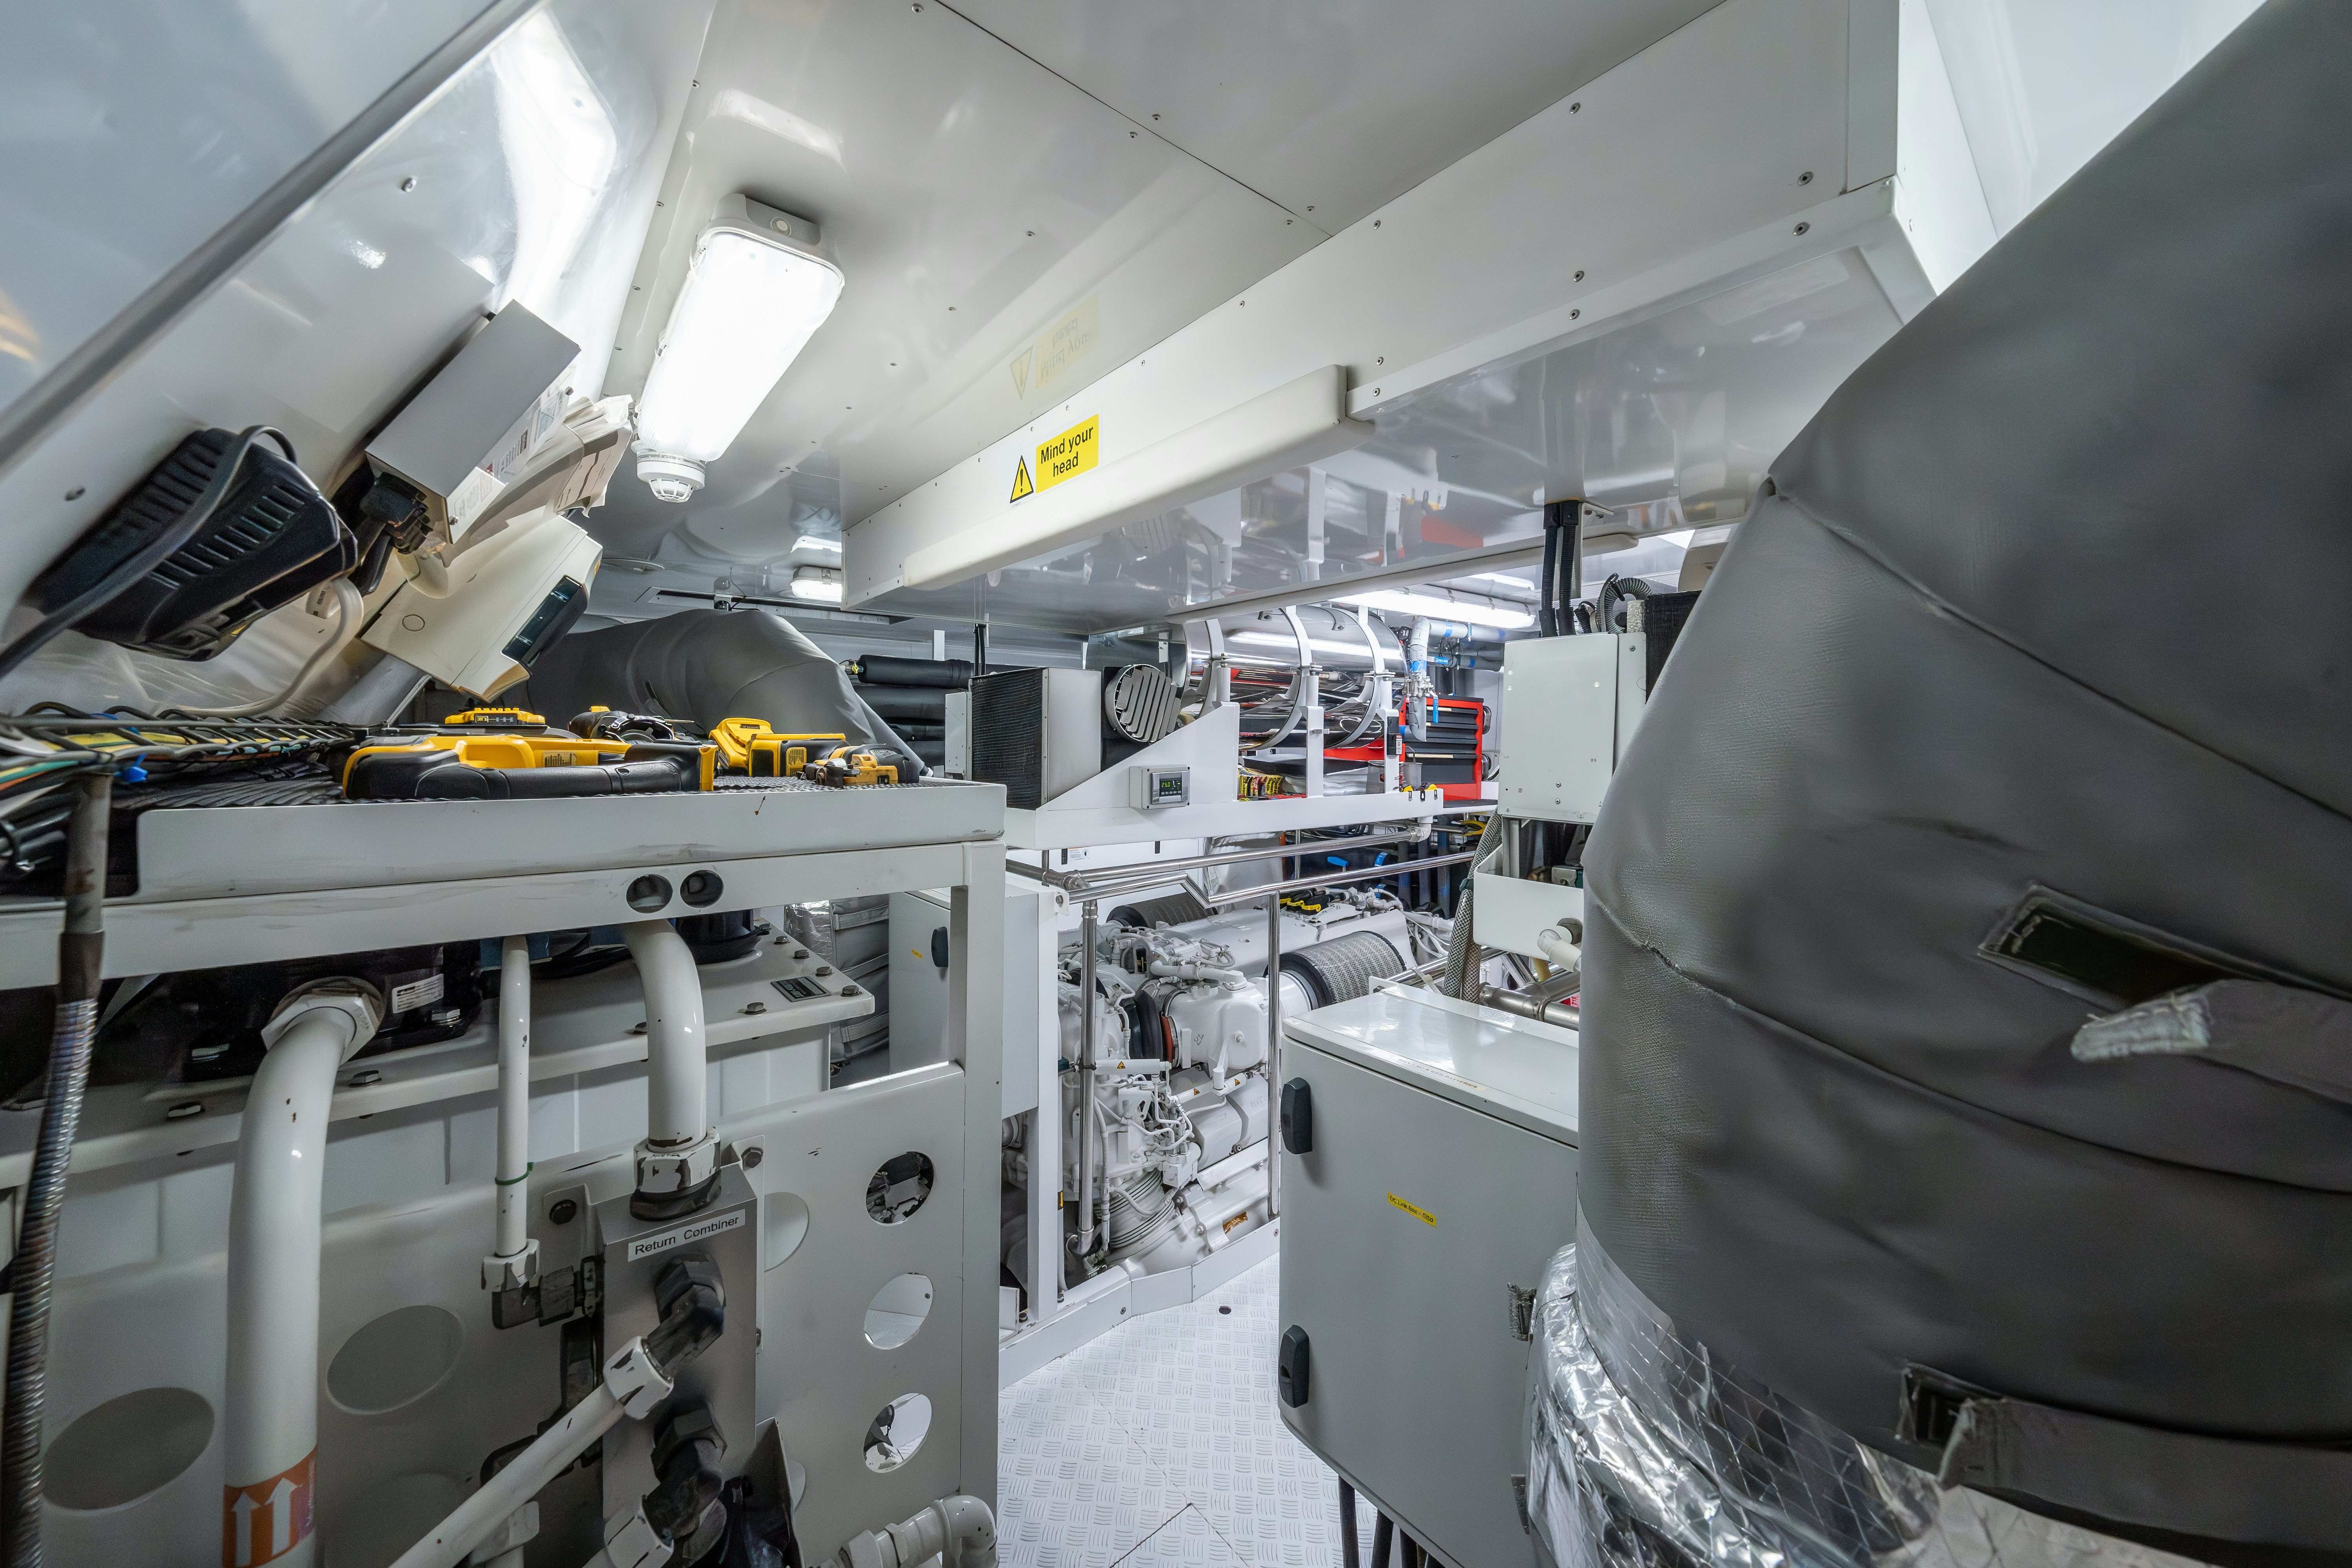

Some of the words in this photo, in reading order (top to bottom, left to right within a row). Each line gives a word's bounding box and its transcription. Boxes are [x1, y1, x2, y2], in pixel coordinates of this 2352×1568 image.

[1041, 438, 1065, 464] Mind
[1069, 426, 1093, 453] your
[1053, 451, 1078, 477] head
[1445, 1075, 1477, 1088] BATTERIES
[1397, 1200, 1408, 1209] Link
[635, 1236, 676, 1255] Return
[683, 1217, 739, 1240] Combiner
